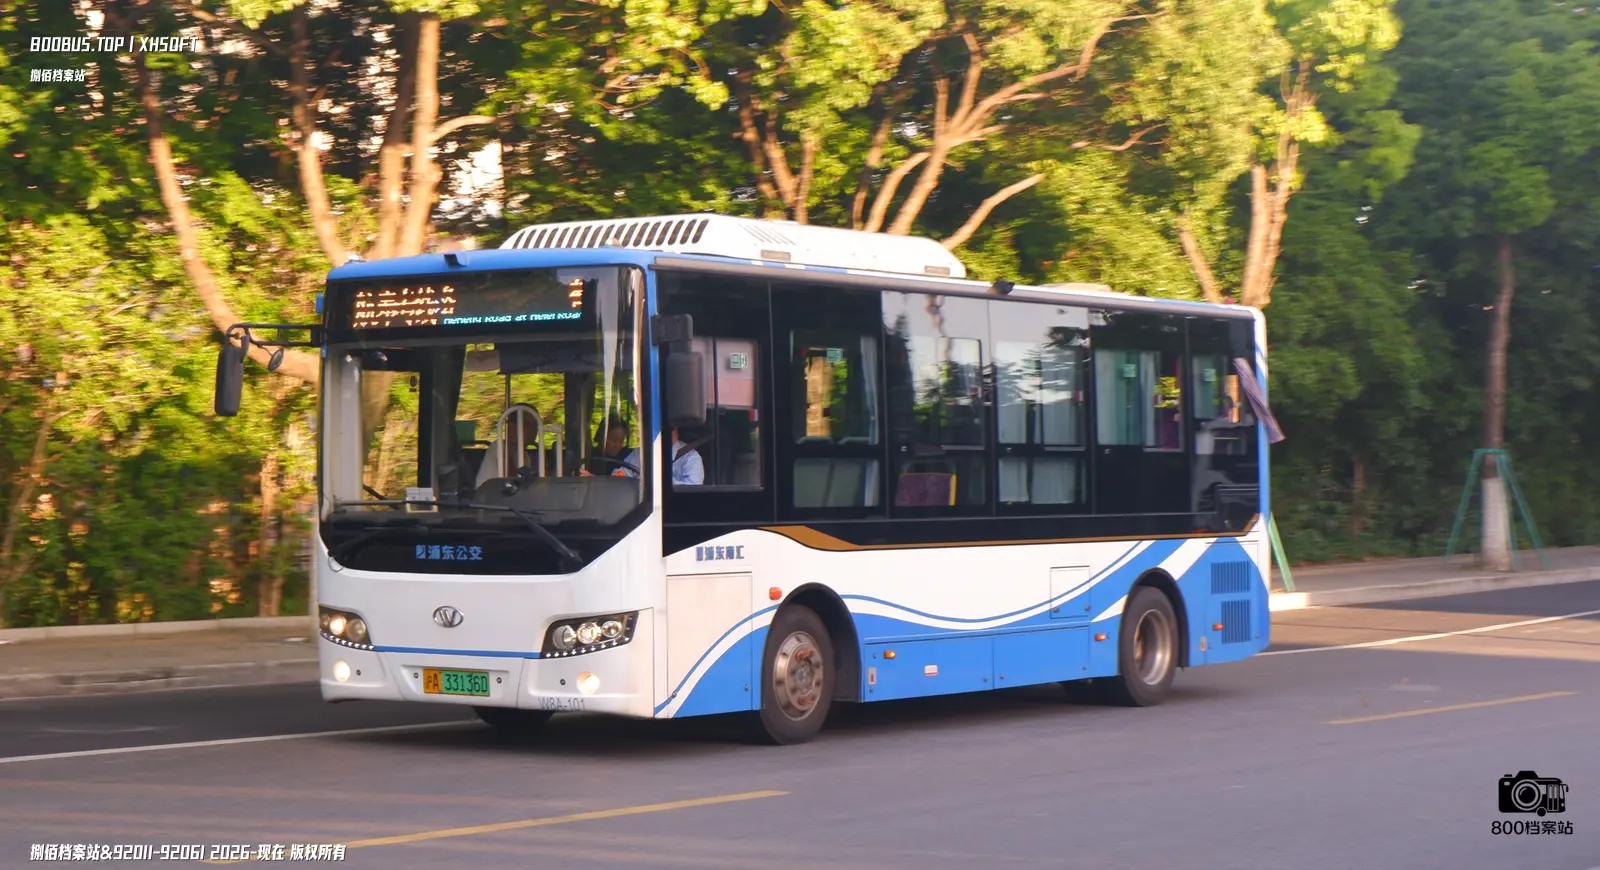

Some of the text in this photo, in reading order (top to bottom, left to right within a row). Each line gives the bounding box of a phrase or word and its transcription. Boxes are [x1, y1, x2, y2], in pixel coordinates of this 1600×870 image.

[428, 545, 483, 560] 浦东公交
[704, 545, 745, 561] 浦东南汇
[445, 673, 488, 693] 33136D
[538, 696, 586, 711] W8A-101
